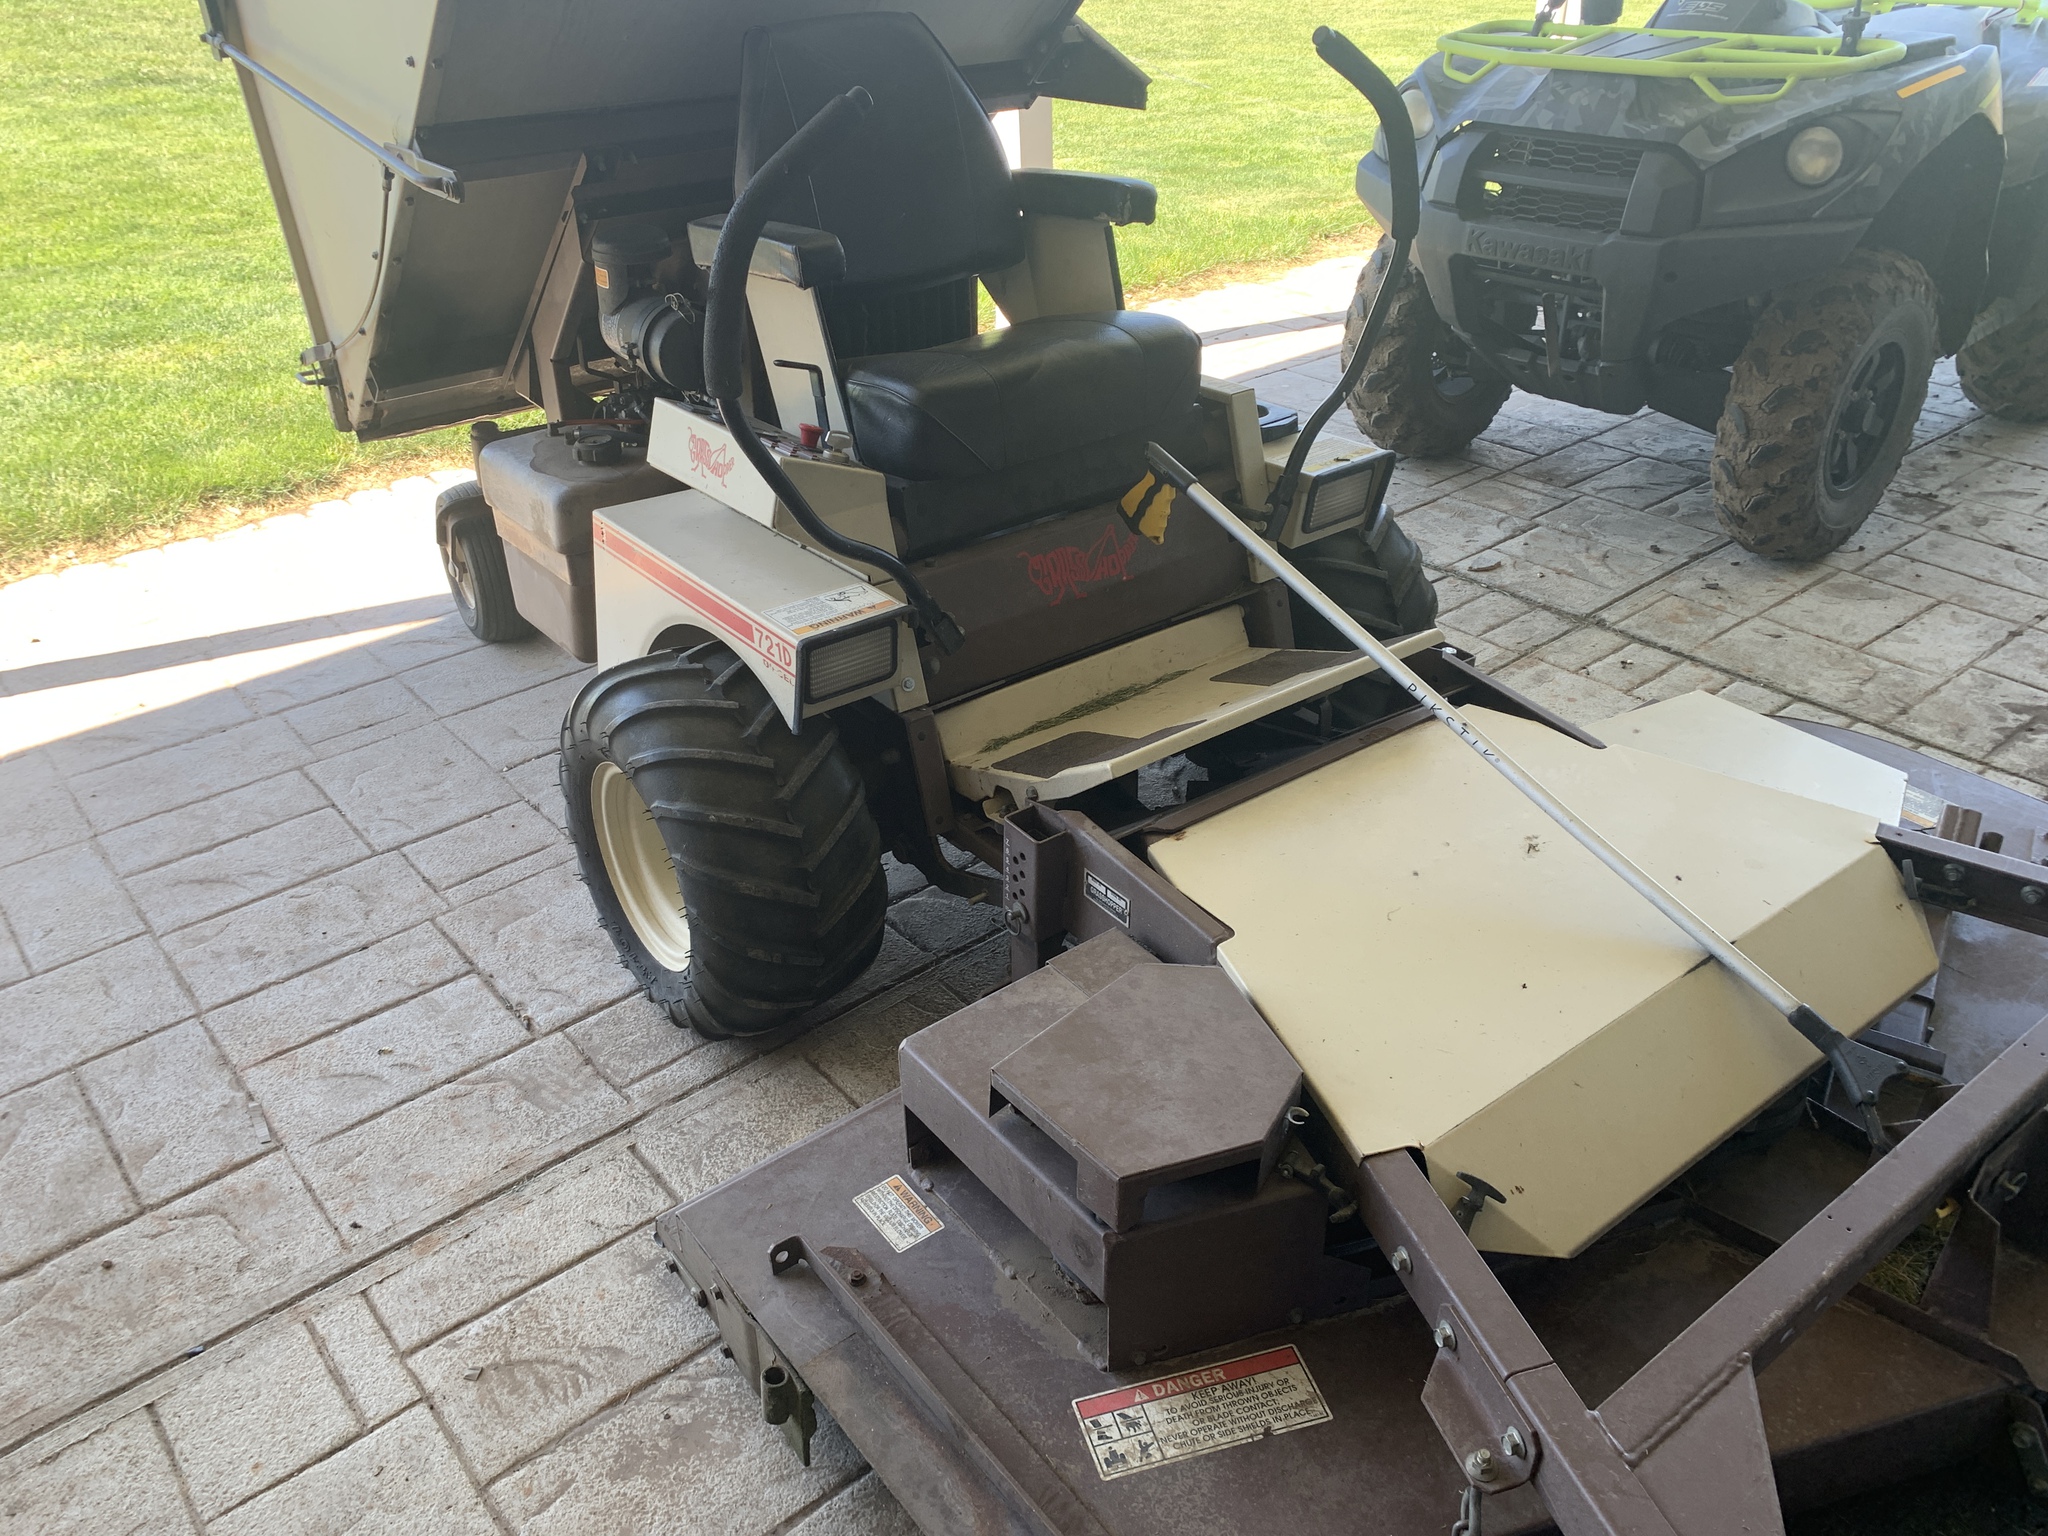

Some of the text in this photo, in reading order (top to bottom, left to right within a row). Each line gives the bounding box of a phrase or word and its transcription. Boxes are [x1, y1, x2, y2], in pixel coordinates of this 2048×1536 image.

[1467, 228, 1593, 272] Kawasaki
[755, 627, 792, 667] 721D
[899, 1190, 933, 1223] WARNING
[1152, 1368, 1226, 1396] DANGER
[1179, 1399, 1207, 1411] AVOID
[1208, 1390, 1244, 1403] SERIOUS
[1245, 1382, 1275, 1394] INJURY
[1276, 1378, 1289, 1386] OR
[1191, 1377, 1256, 1399] KEEP AWAY!
[1160, 1431, 1188, 1443] NEVER
[1189, 1421, 1227, 1435] OPERATE
[1228, 1410, 1266, 1425] WITHOUT
[1267, 1397, 1317, 1415] DISCHARGE
[1165, 1385, 1297, 1423] DEATH FROM THROWN OBJECTS
[1192, 1418, 1205, 1426] OR
[1207, 1410, 1234, 1422] BLADE
[1172, 1437, 1201, 1449] CHUTE
[1202, 1433, 1216, 1441] OR
[1217, 1427, 1236, 1437] SIDE
[1237, 1418, 1271, 1432] SHIELDS
[1272, 1415, 1282, 1423] IN
